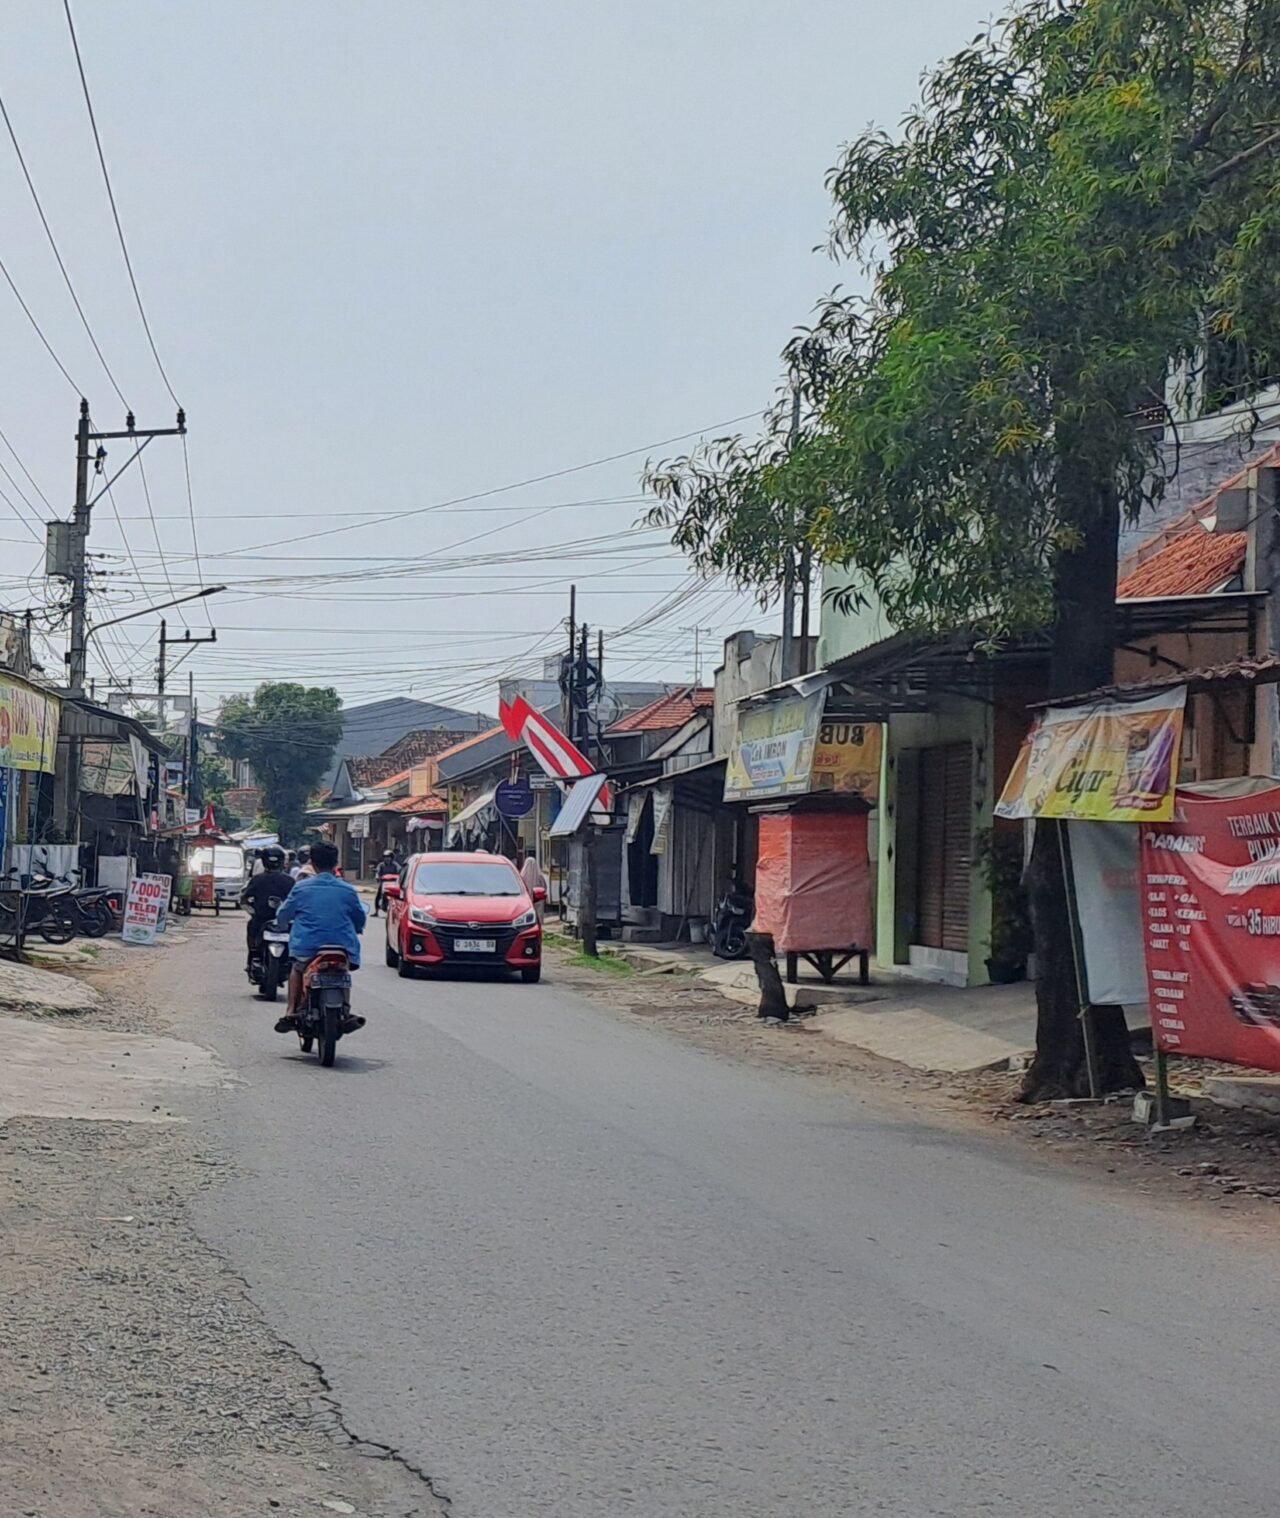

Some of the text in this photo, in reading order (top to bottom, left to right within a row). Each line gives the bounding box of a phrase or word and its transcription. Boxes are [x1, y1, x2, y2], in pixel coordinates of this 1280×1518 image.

[1055, 757, 1113, 804] Cigar
[1226, 812, 1275, 837] TERBAIK
[131, 880, 161, 898] 7.000
[128, 901, 157, 914] TELER
[1247, 908, 1261, 934] 35
